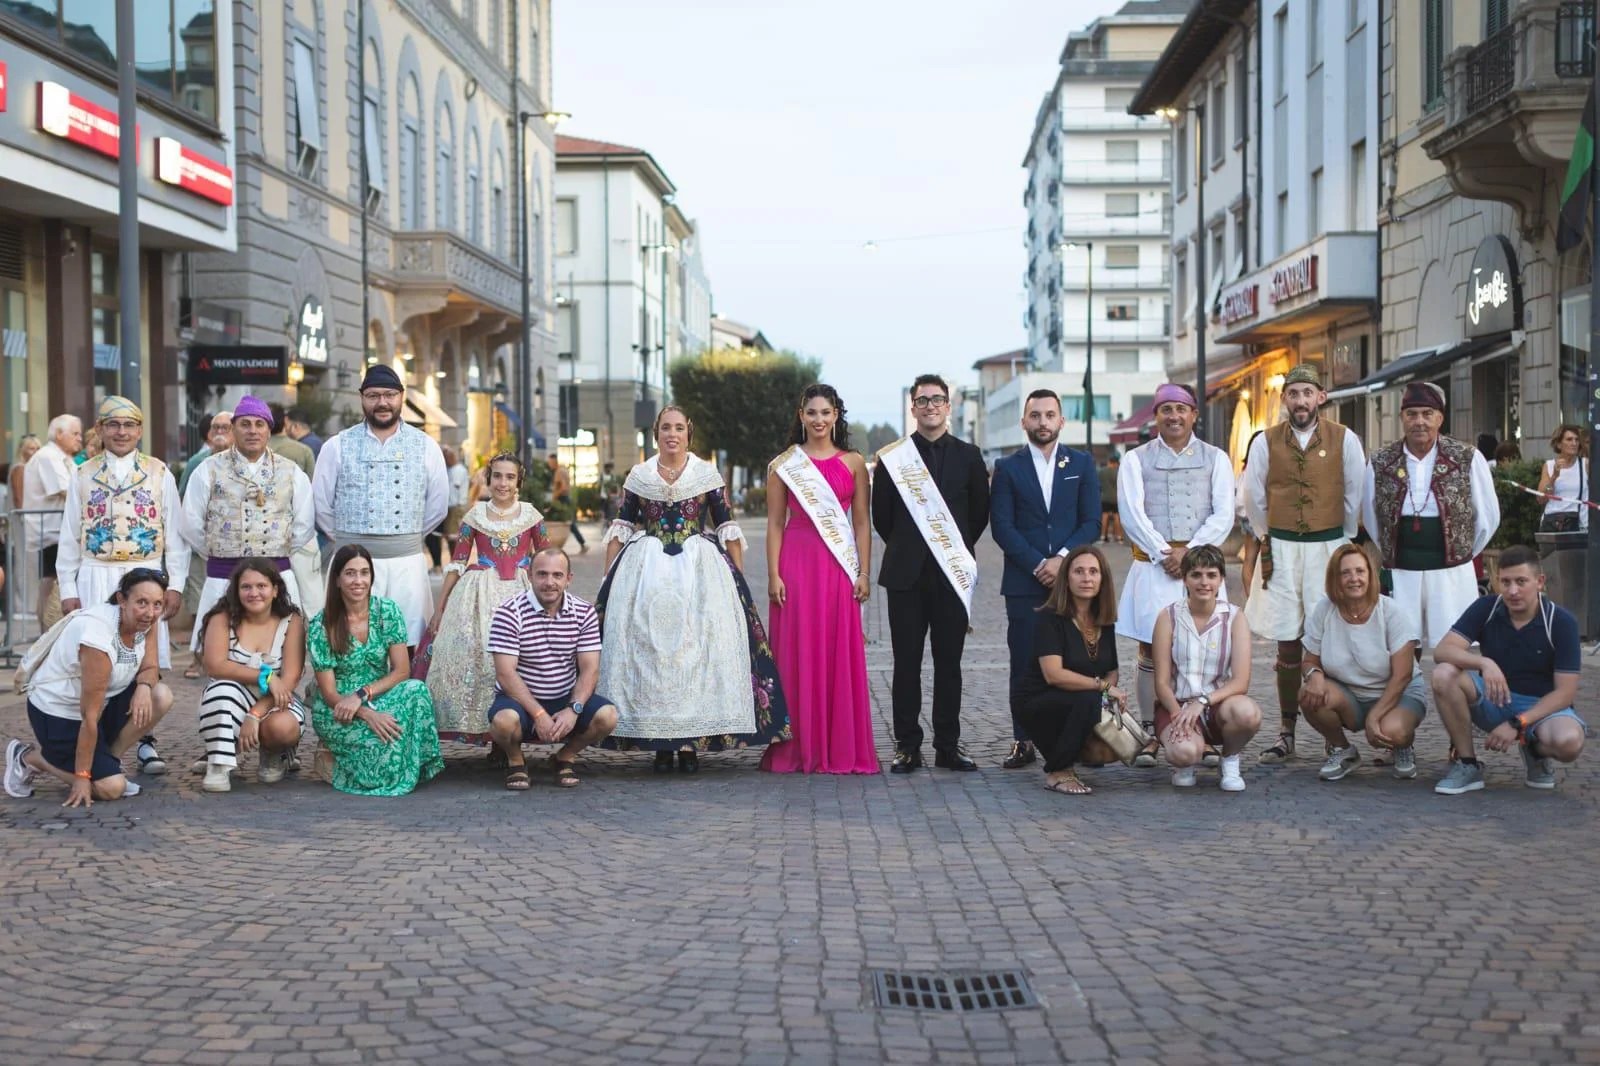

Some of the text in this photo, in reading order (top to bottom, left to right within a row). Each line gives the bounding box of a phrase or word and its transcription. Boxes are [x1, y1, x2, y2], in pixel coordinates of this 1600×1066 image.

[213, 358, 279, 369] MONDADORI
[784, 463, 820, 507] Madrina
[816, 508, 843, 545] Targa
[926, 511, 953, 551] Targa
[947, 551, 972, 592] Cecina
